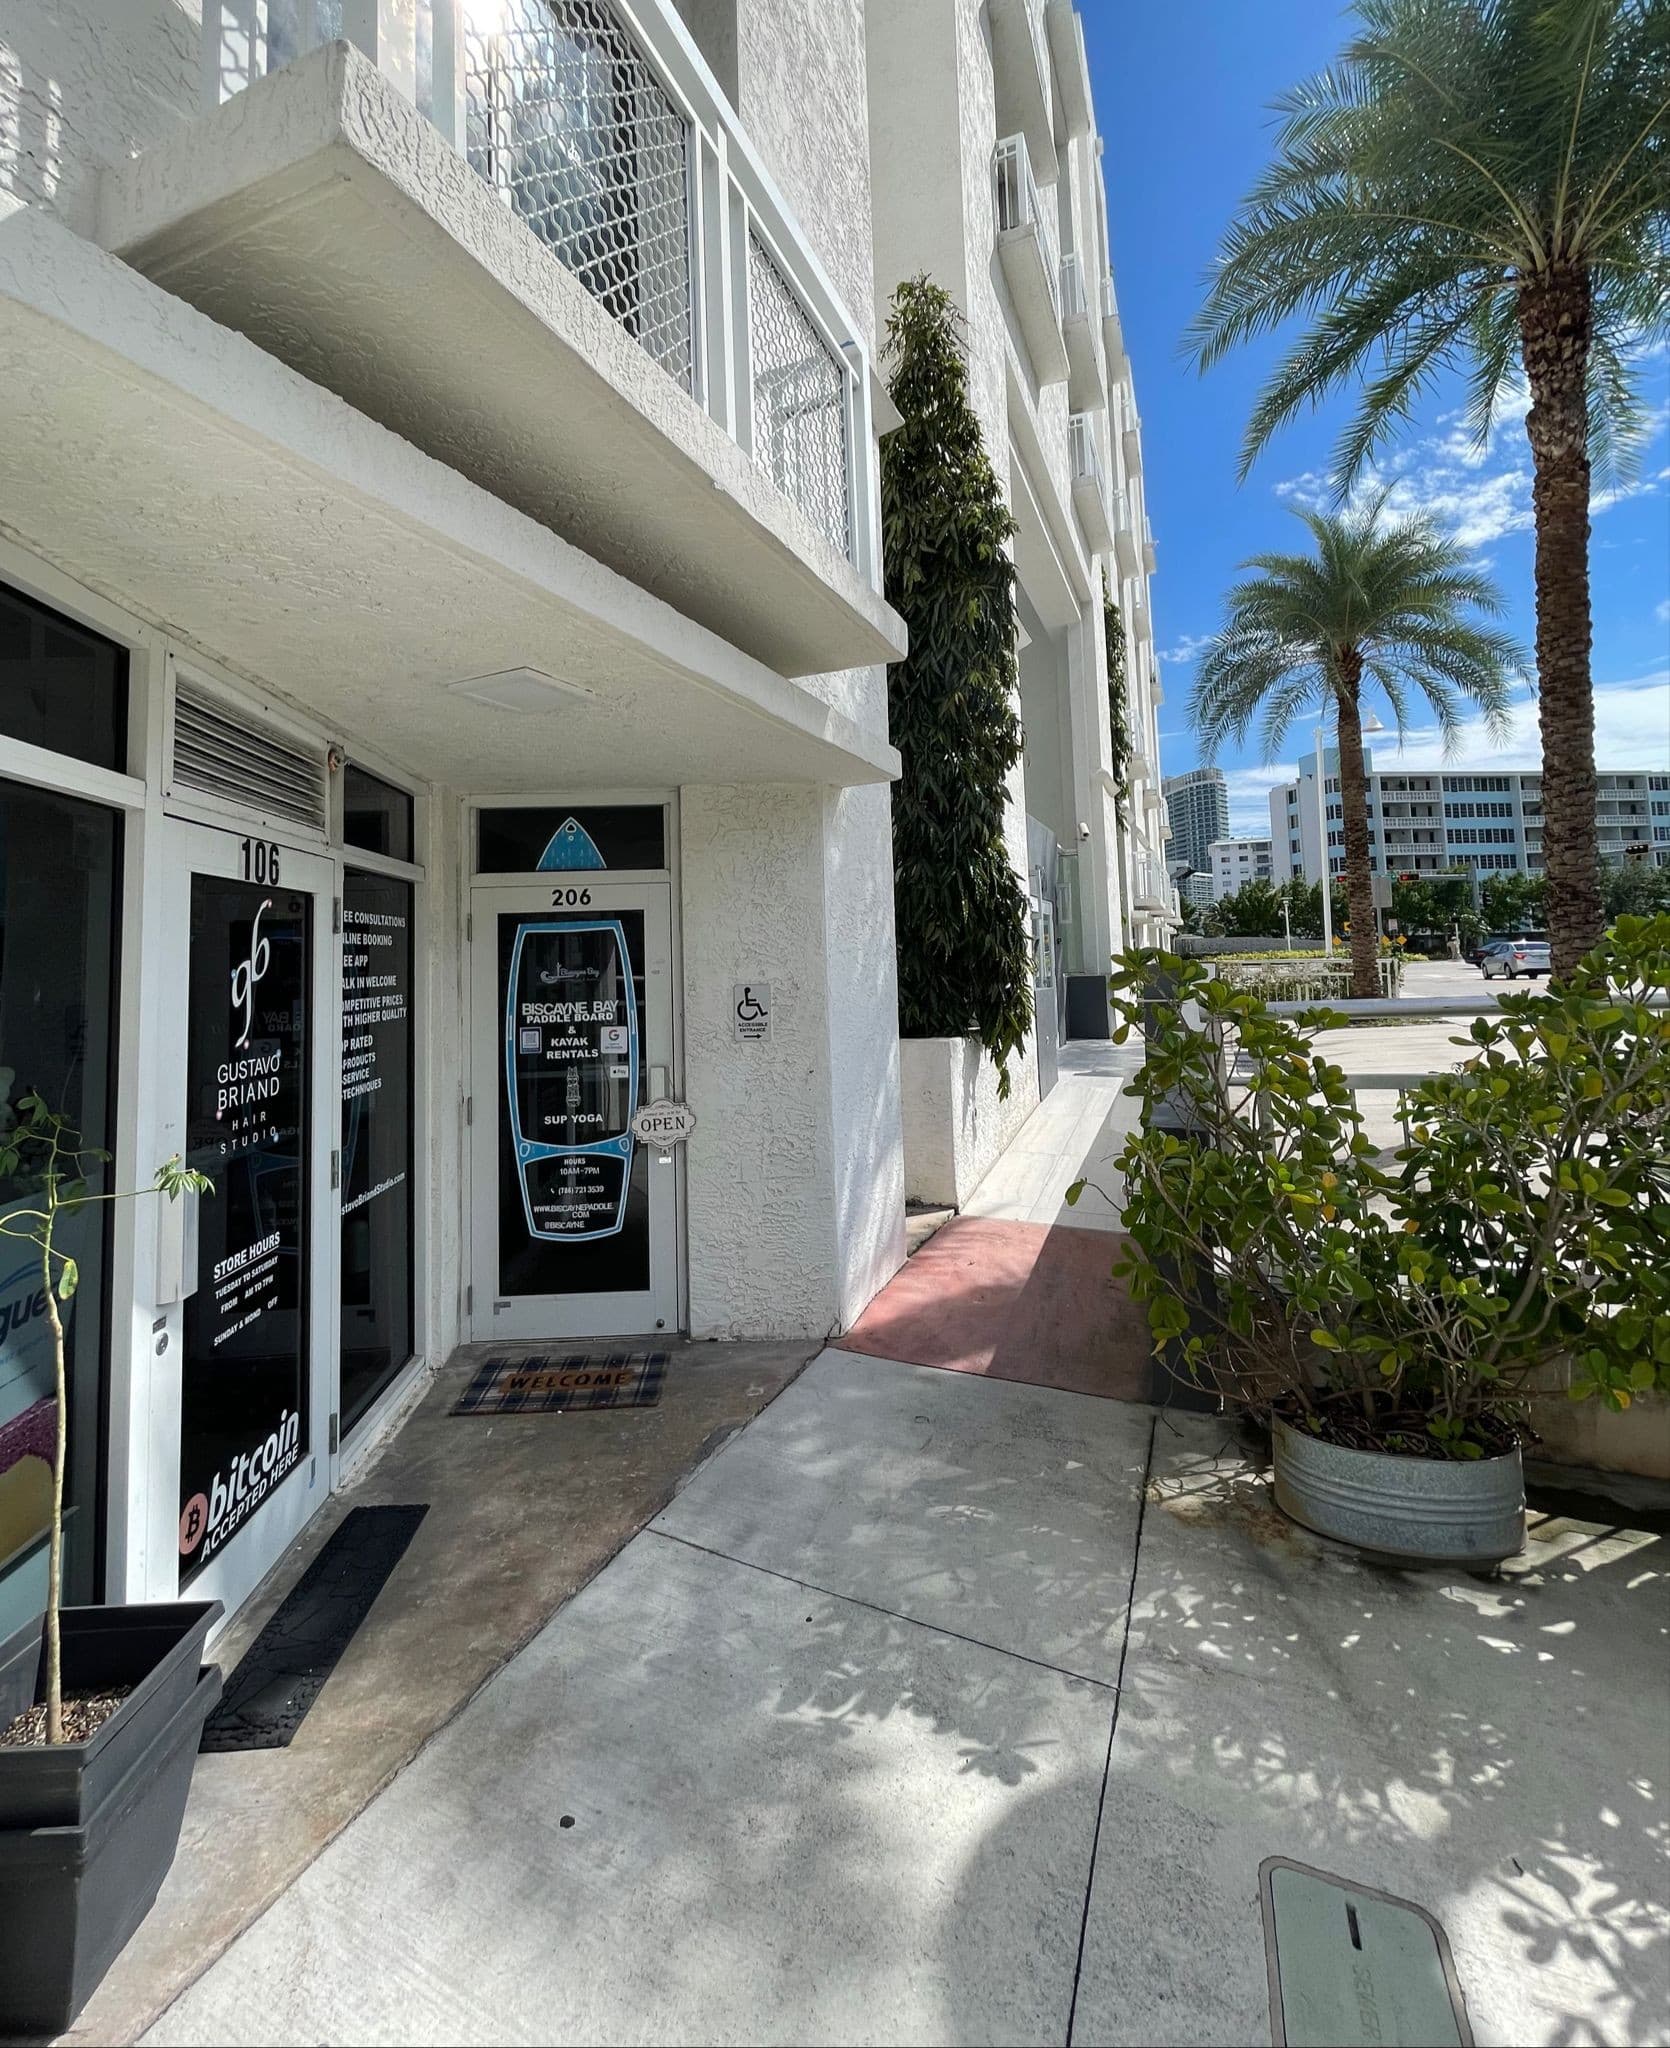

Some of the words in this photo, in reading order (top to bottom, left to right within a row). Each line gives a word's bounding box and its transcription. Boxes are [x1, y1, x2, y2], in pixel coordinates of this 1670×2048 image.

[242, 839, 280, 885] 106
[551, 888, 591, 906] 206
[354, 911, 406, 928] CONSULTATIONS
[342, 932, 361, 945] LINE
[362, 934, 393, 946] BOOKING
[354, 955, 368, 967] APP
[356, 976, 365, 989] IN
[365, 975, 397, 988] WELCOME
[341, 996, 381, 1012] MPETITIVE
[382, 994, 404, 1007] PRICES
[522, 1002, 588, 1016] BISCAYNE
[593, 1000, 619, 1013] BAY
[354, 1011, 381, 1026] HIGHER
[381, 1006, 407, 1021] QUALITY
[526, 1014, 571, 1024] PADDLE
[574, 1012, 614, 1022] BOARD
[568, 1025, 576, 1035] &
[350, 1034, 374, 1051] RATED
[550, 1036, 589, 1047] KAYAK
[546, 1048, 599, 1060] RENTALS
[217, 1054, 281, 1085] GUSTAVO
[217, 1076, 281, 1111] BRIAND
[232, 1110, 267, 1131] HAIR
[544, 1115, 567, 1125] SUP
[571, 1113, 604, 1123] YOGA
[640, 1115, 686, 1132] OPEN
[220, 1124, 277, 1155] STUDIO
[563, 1157, 586, 1165] HOURS
[213, 1247, 248, 1280] STORE
[249, 1231, 280, 1260] HOURS
[215, 1277, 242, 1300] TUESDAY
[243, 1271, 251, 1283] TO
[251, 1255, 279, 1278] SATURDAY
[220, 1296, 238, 1314] FROM
[244, 1286, 254, 1299] AM
[254, 1281, 262, 1293] TO
[214, 1323, 239, 1347] SUNDAY
[267, 1295, 279, 1310] OFF
[509, 1372, 627, 1390] WELCOME
[207, 1408, 299, 1533] bitcoin
[200, 1477, 268, 1564] ACCEPTED
[269, 1442, 299, 1487] HERE
